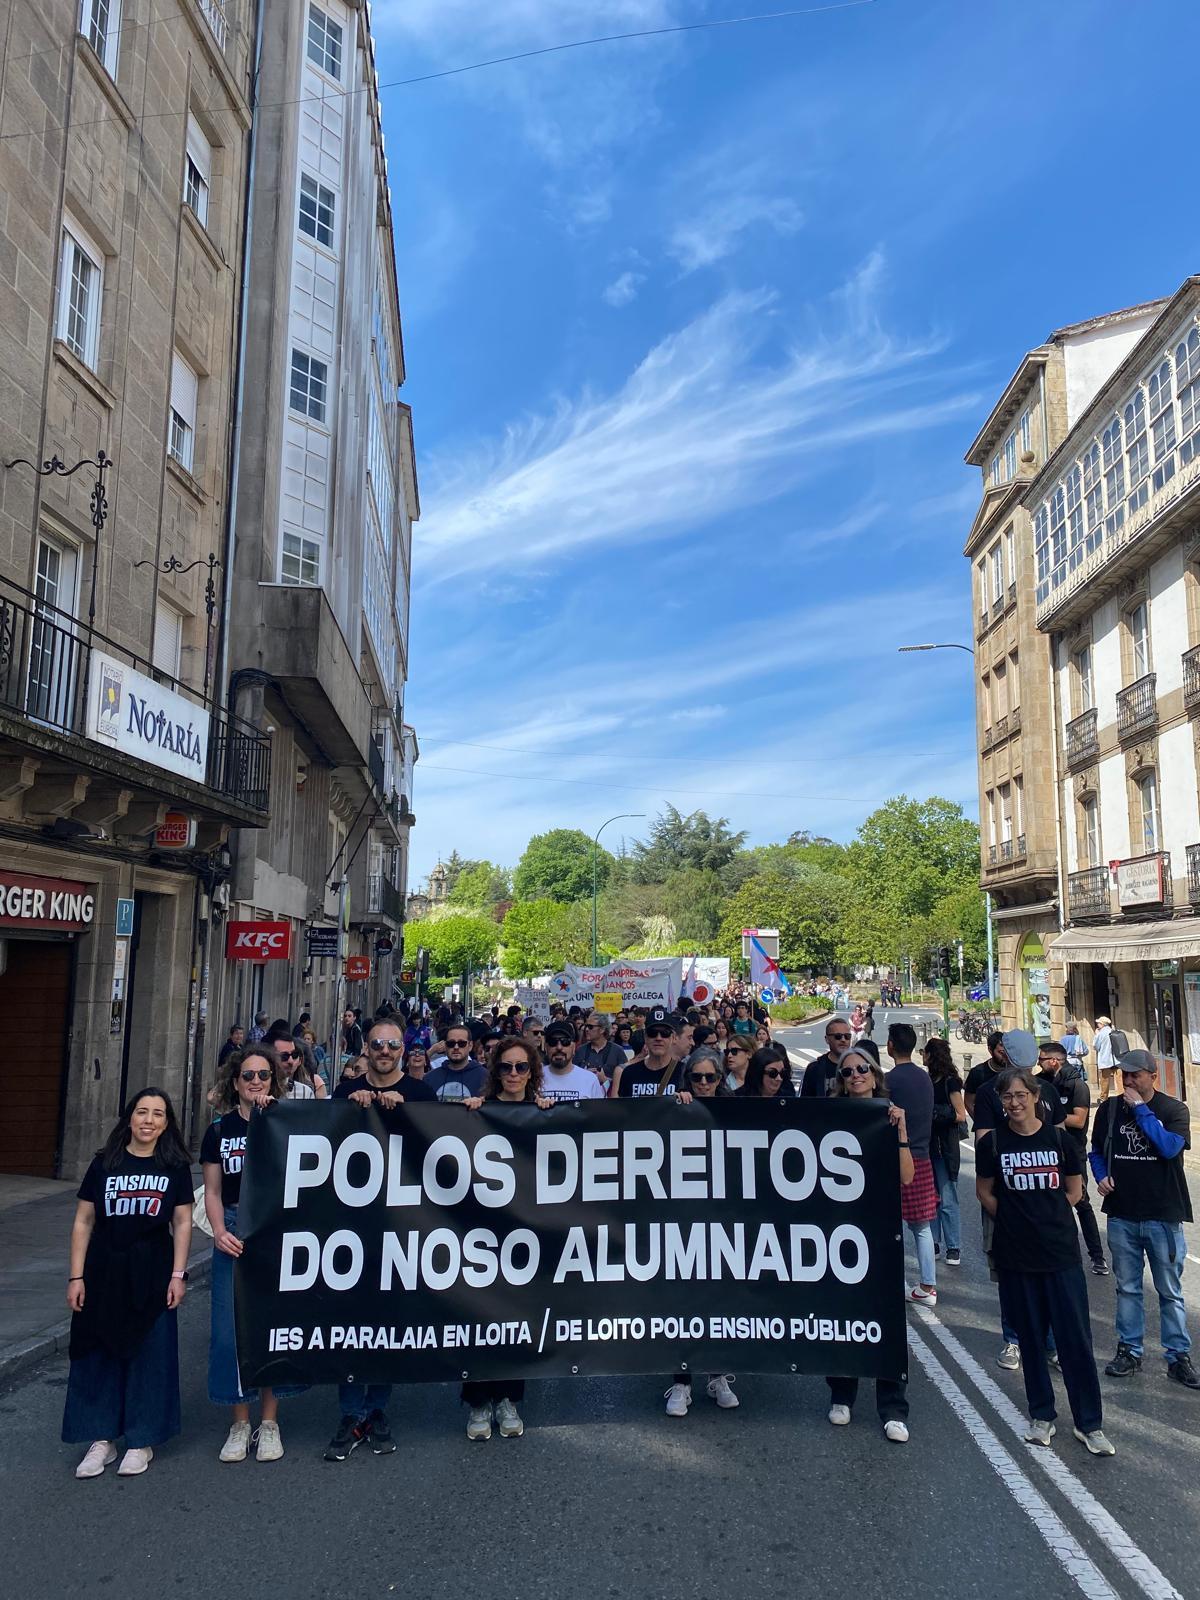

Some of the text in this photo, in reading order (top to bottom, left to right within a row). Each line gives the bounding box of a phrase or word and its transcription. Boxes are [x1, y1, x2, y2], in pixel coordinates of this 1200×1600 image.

[156, 830, 187, 841] KING
[49, 891, 94, 923] KING
[121, 903, 129, 921] P
[234, 932, 285, 948] KFC
[632, 991, 664, 1000] GALEGA
[632, 1083, 676, 1096] ENSIO
[1001, 1150, 1059, 1168] ENSINO
[284, 1129, 865, 1208] POLOS DEREITOS
[105, 1174, 169, 1192] ENSINO
[105, 1190, 117, 1199] EN
[279, 1222, 869, 1291] DO NOSO ALUMNADO
[268, 1327, 304, 1352] IES
[308, 1327, 325, 1350] A
[330, 1326, 438, 1349] PARALAIA
[443, 1324, 471, 1348] EN
[475, 1321, 532, 1346] LOITA
[555, 1319, 583, 1342] DE
[587, 1317, 646, 1340] LOITO
[651, 1316, 705, 1339] POLO
[709, 1317, 785, 1339] ENSINO
[790, 1313, 882, 1344] PÚBLICO
